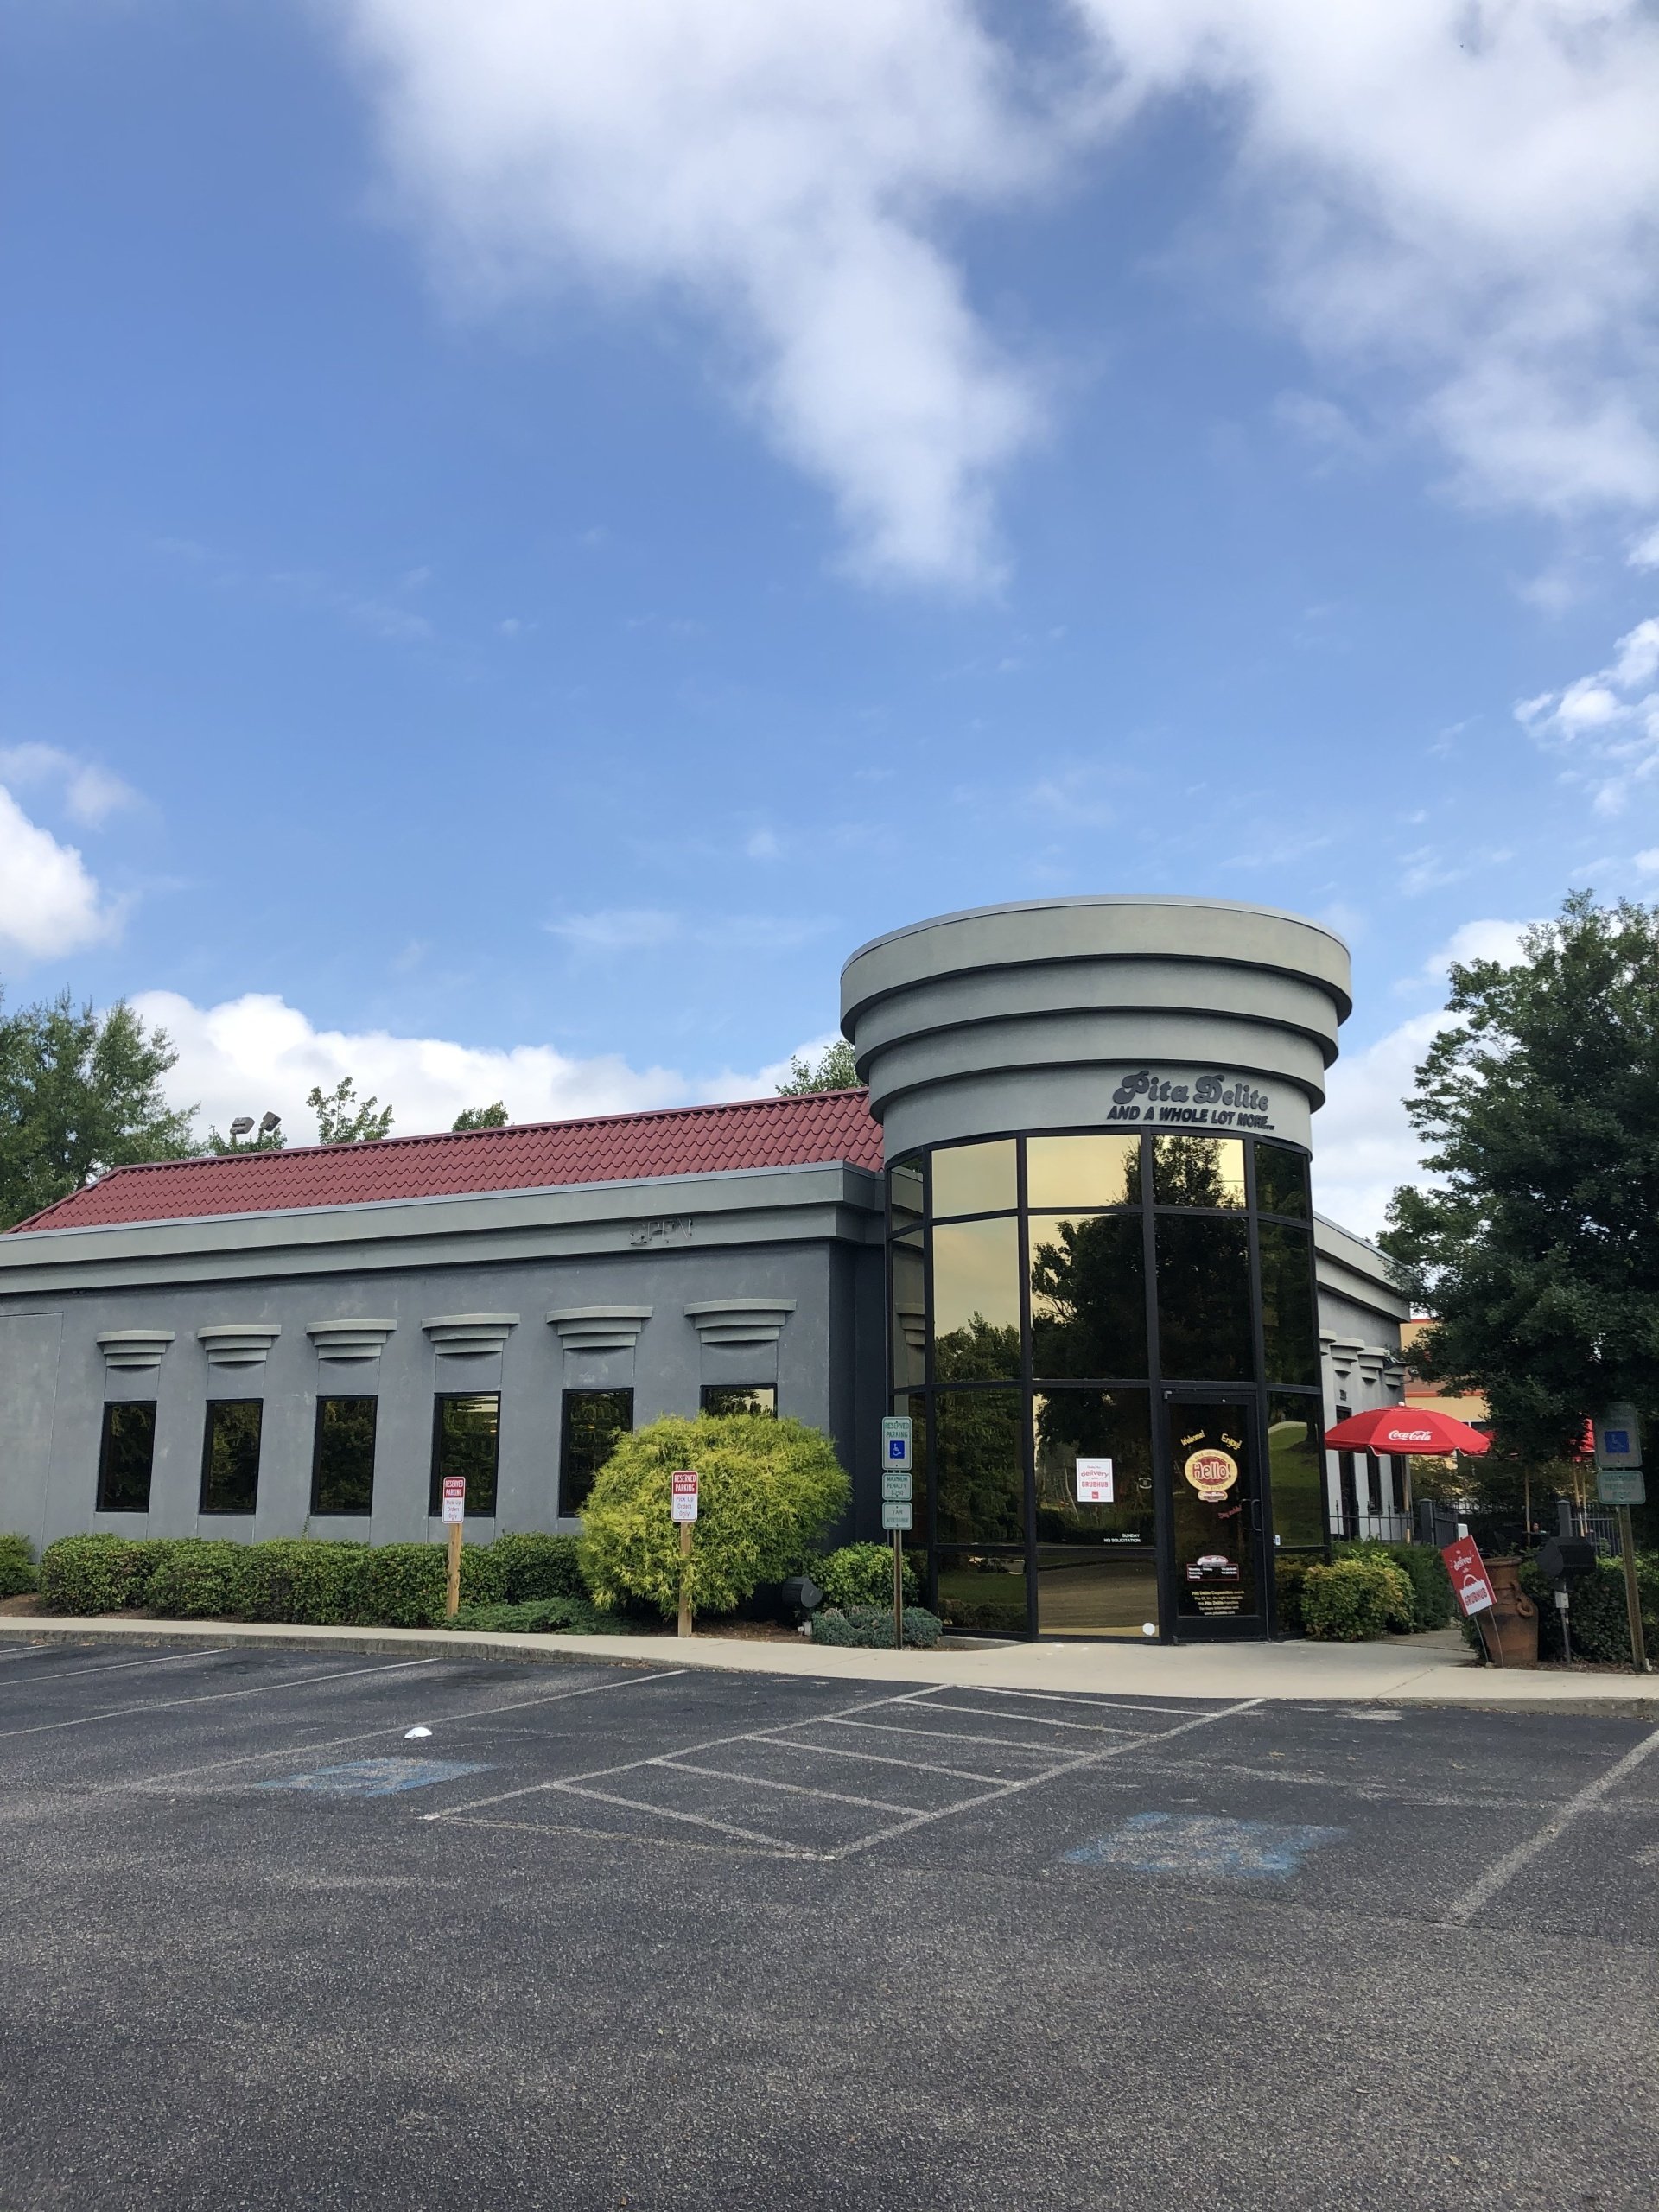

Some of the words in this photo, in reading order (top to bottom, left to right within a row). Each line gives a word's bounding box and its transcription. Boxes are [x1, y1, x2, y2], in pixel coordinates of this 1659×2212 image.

[1112, 1070, 1189, 1105] Pita
[1192, 1074, 1269, 1112] Delite
[1106, 1105, 1141, 1121] AND
[1143, 1106, 1155, 1121] A
[1159, 1107, 1210, 1124] WHOLE
[1211, 1109, 1236, 1125] LOT
[1388, 1429, 1433, 1441] Coca-Cola
[1221, 1433, 1243, 1451] Enjoy!
[1080, 1469, 1109, 1478] delivery
[1192, 1462, 1231, 1479] Hello!
[445, 1479, 464, 1488] RESERVED
[674, 1474, 696, 1483] RESERVED
[445, 1488, 462, 1497] PARKING
[675, 1484, 695, 1492] PARKING
[1453, 1556, 1473, 1571] deliver
[1464, 1587, 1488, 1606] GRUBHUB
